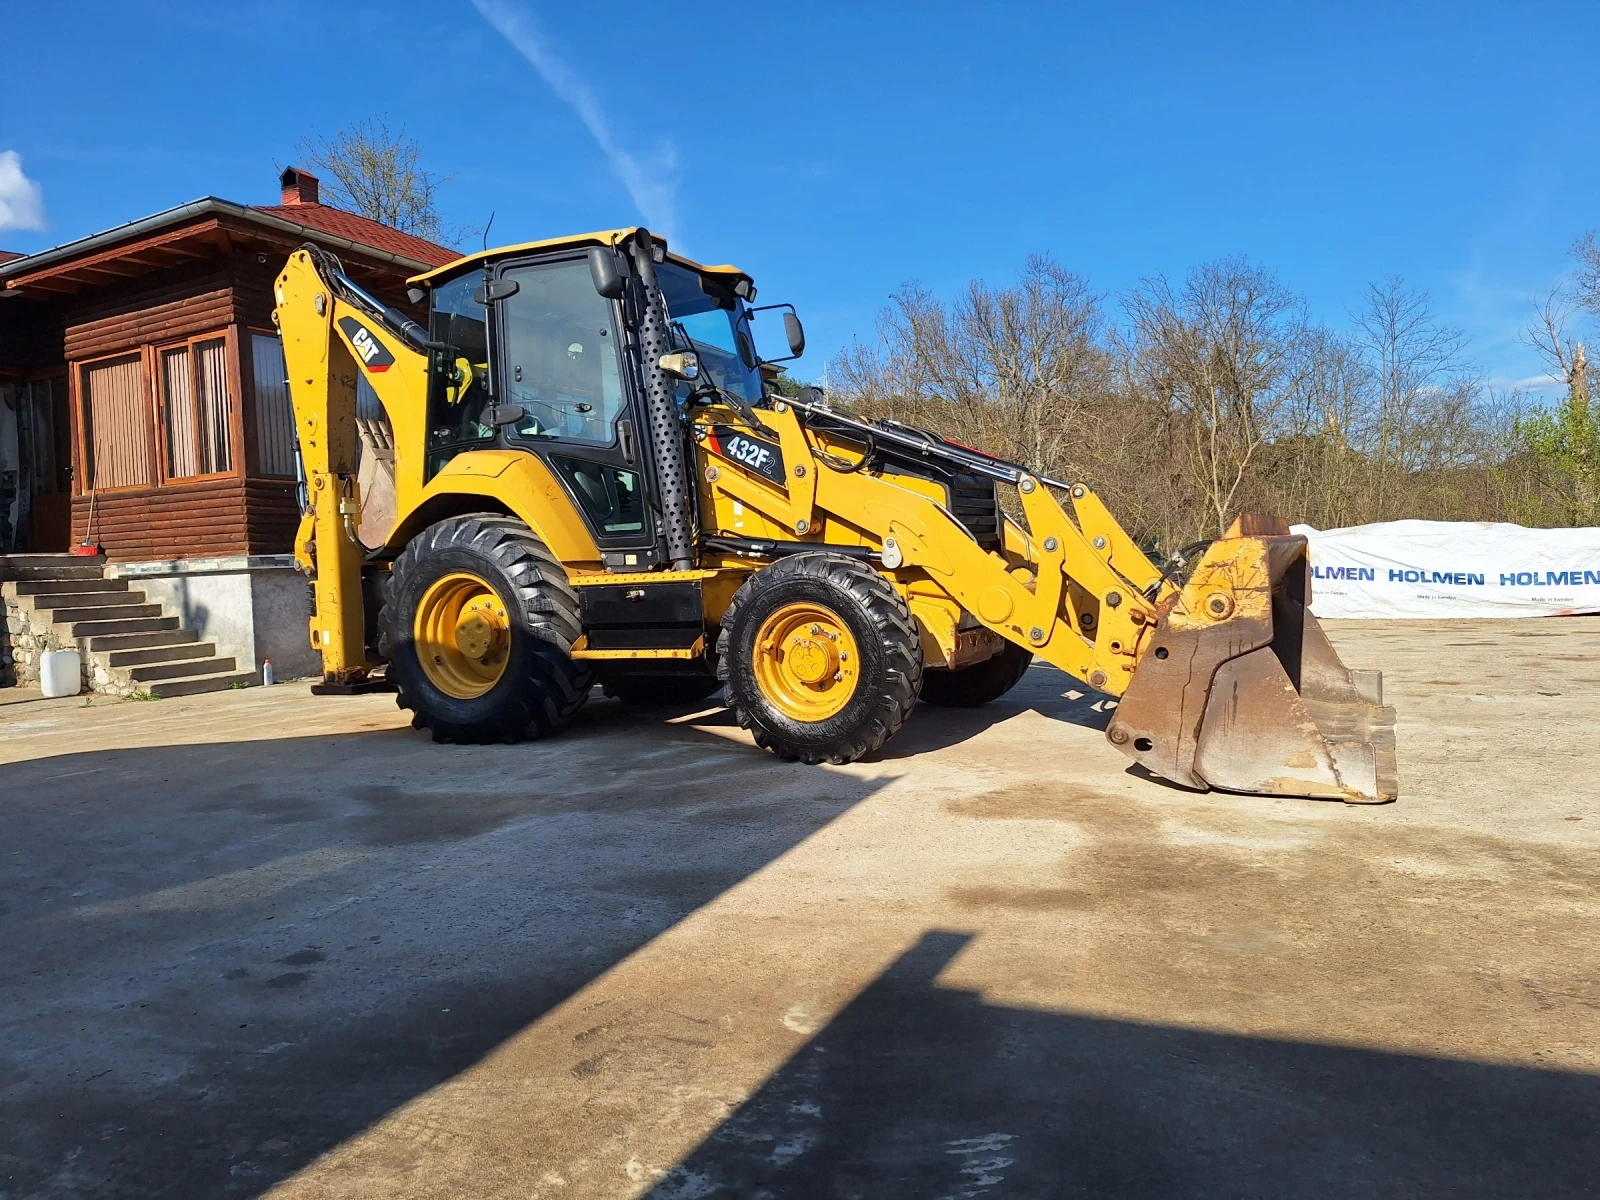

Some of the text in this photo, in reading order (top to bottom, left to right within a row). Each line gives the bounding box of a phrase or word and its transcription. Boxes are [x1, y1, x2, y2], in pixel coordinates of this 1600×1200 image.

[352, 327, 380, 363] CAT
[1388, 569, 1485, 586] HOLMEN
[1499, 570, 1600, 586] HOLMEN
